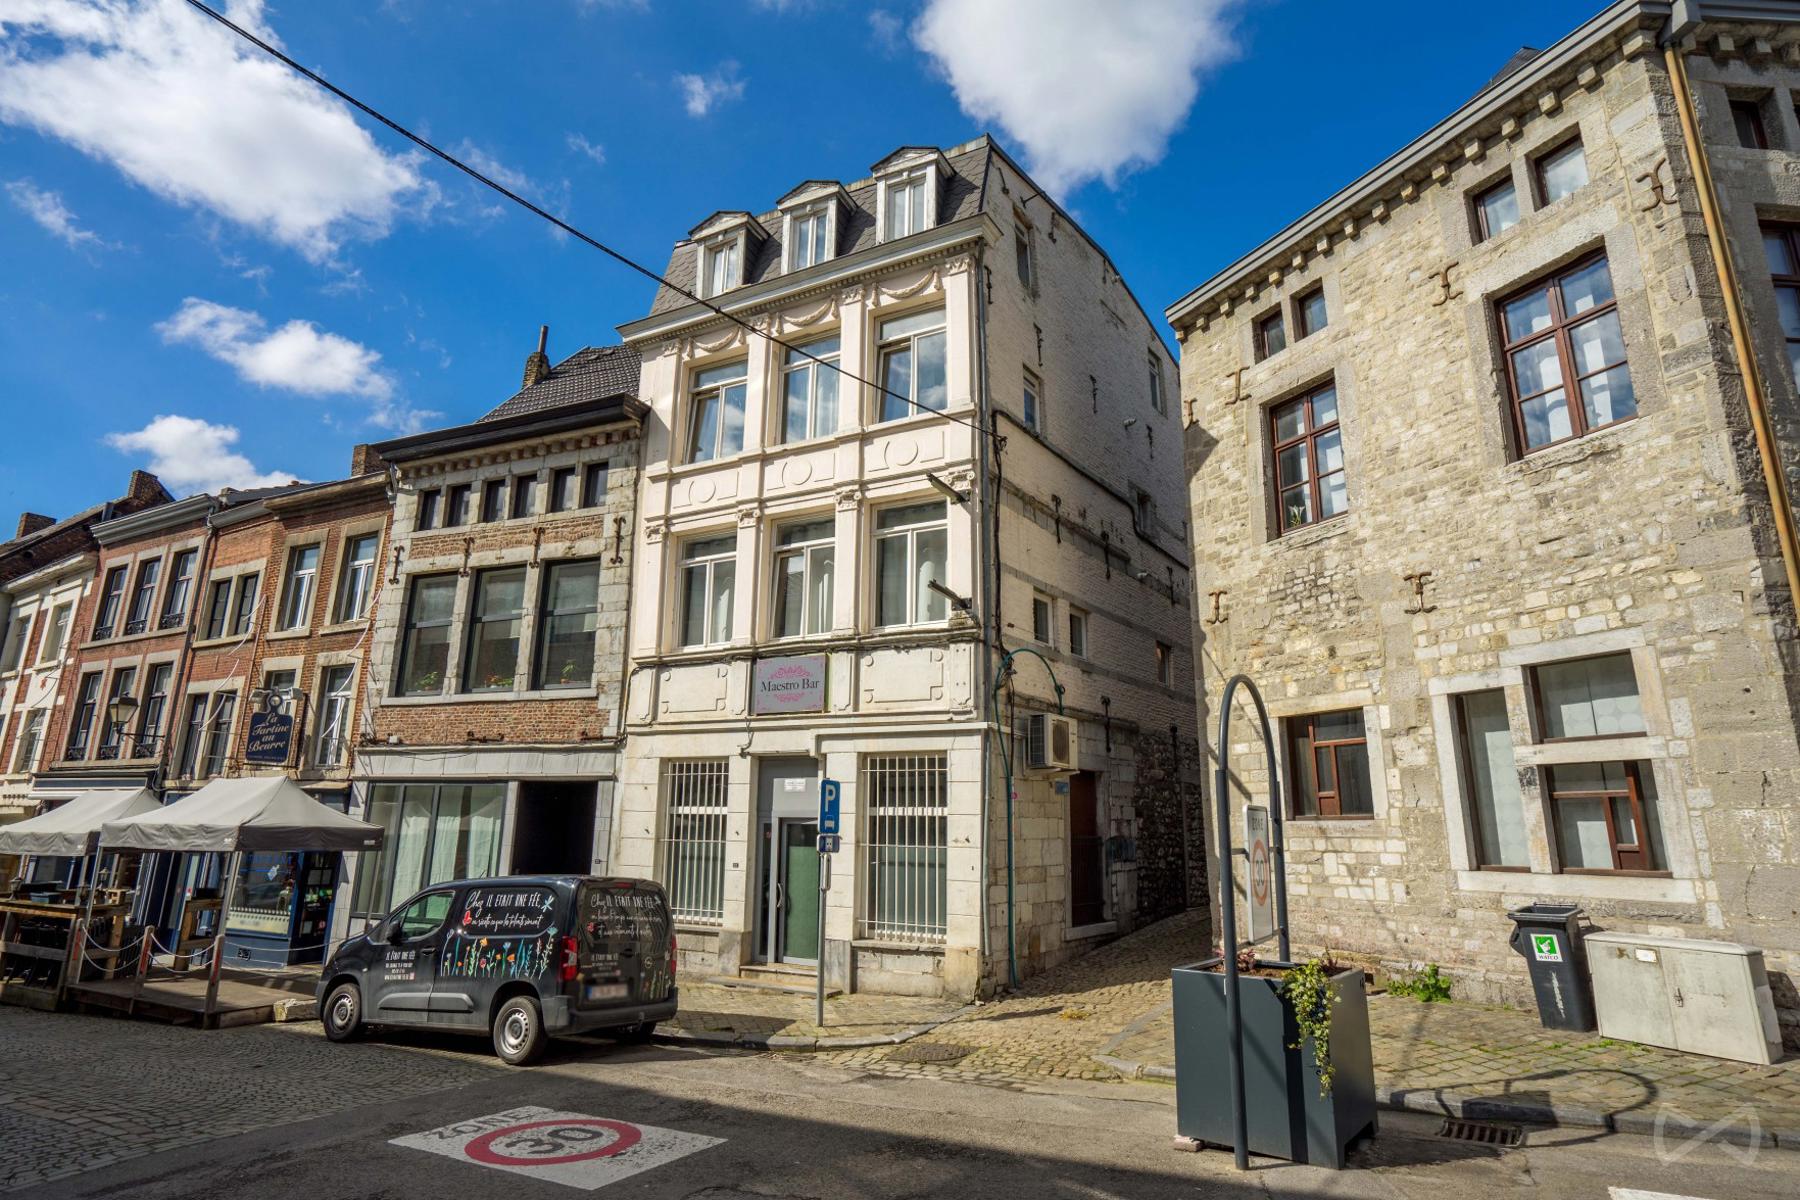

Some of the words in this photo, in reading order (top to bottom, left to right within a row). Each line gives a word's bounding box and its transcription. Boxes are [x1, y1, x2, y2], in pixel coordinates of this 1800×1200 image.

[761, 680, 800, 692] Maestro
[802, 678, 820, 690] Bar
[266, 712, 278, 723] La
[252, 723, 289, 735] Tartine
[247, 741, 286, 752] Beurre
[825, 784, 836, 812] P
[465, 890, 484, 918] Chez
[424, 1111, 538, 1140] ZONE
[504, 1127, 604, 1154] 30
